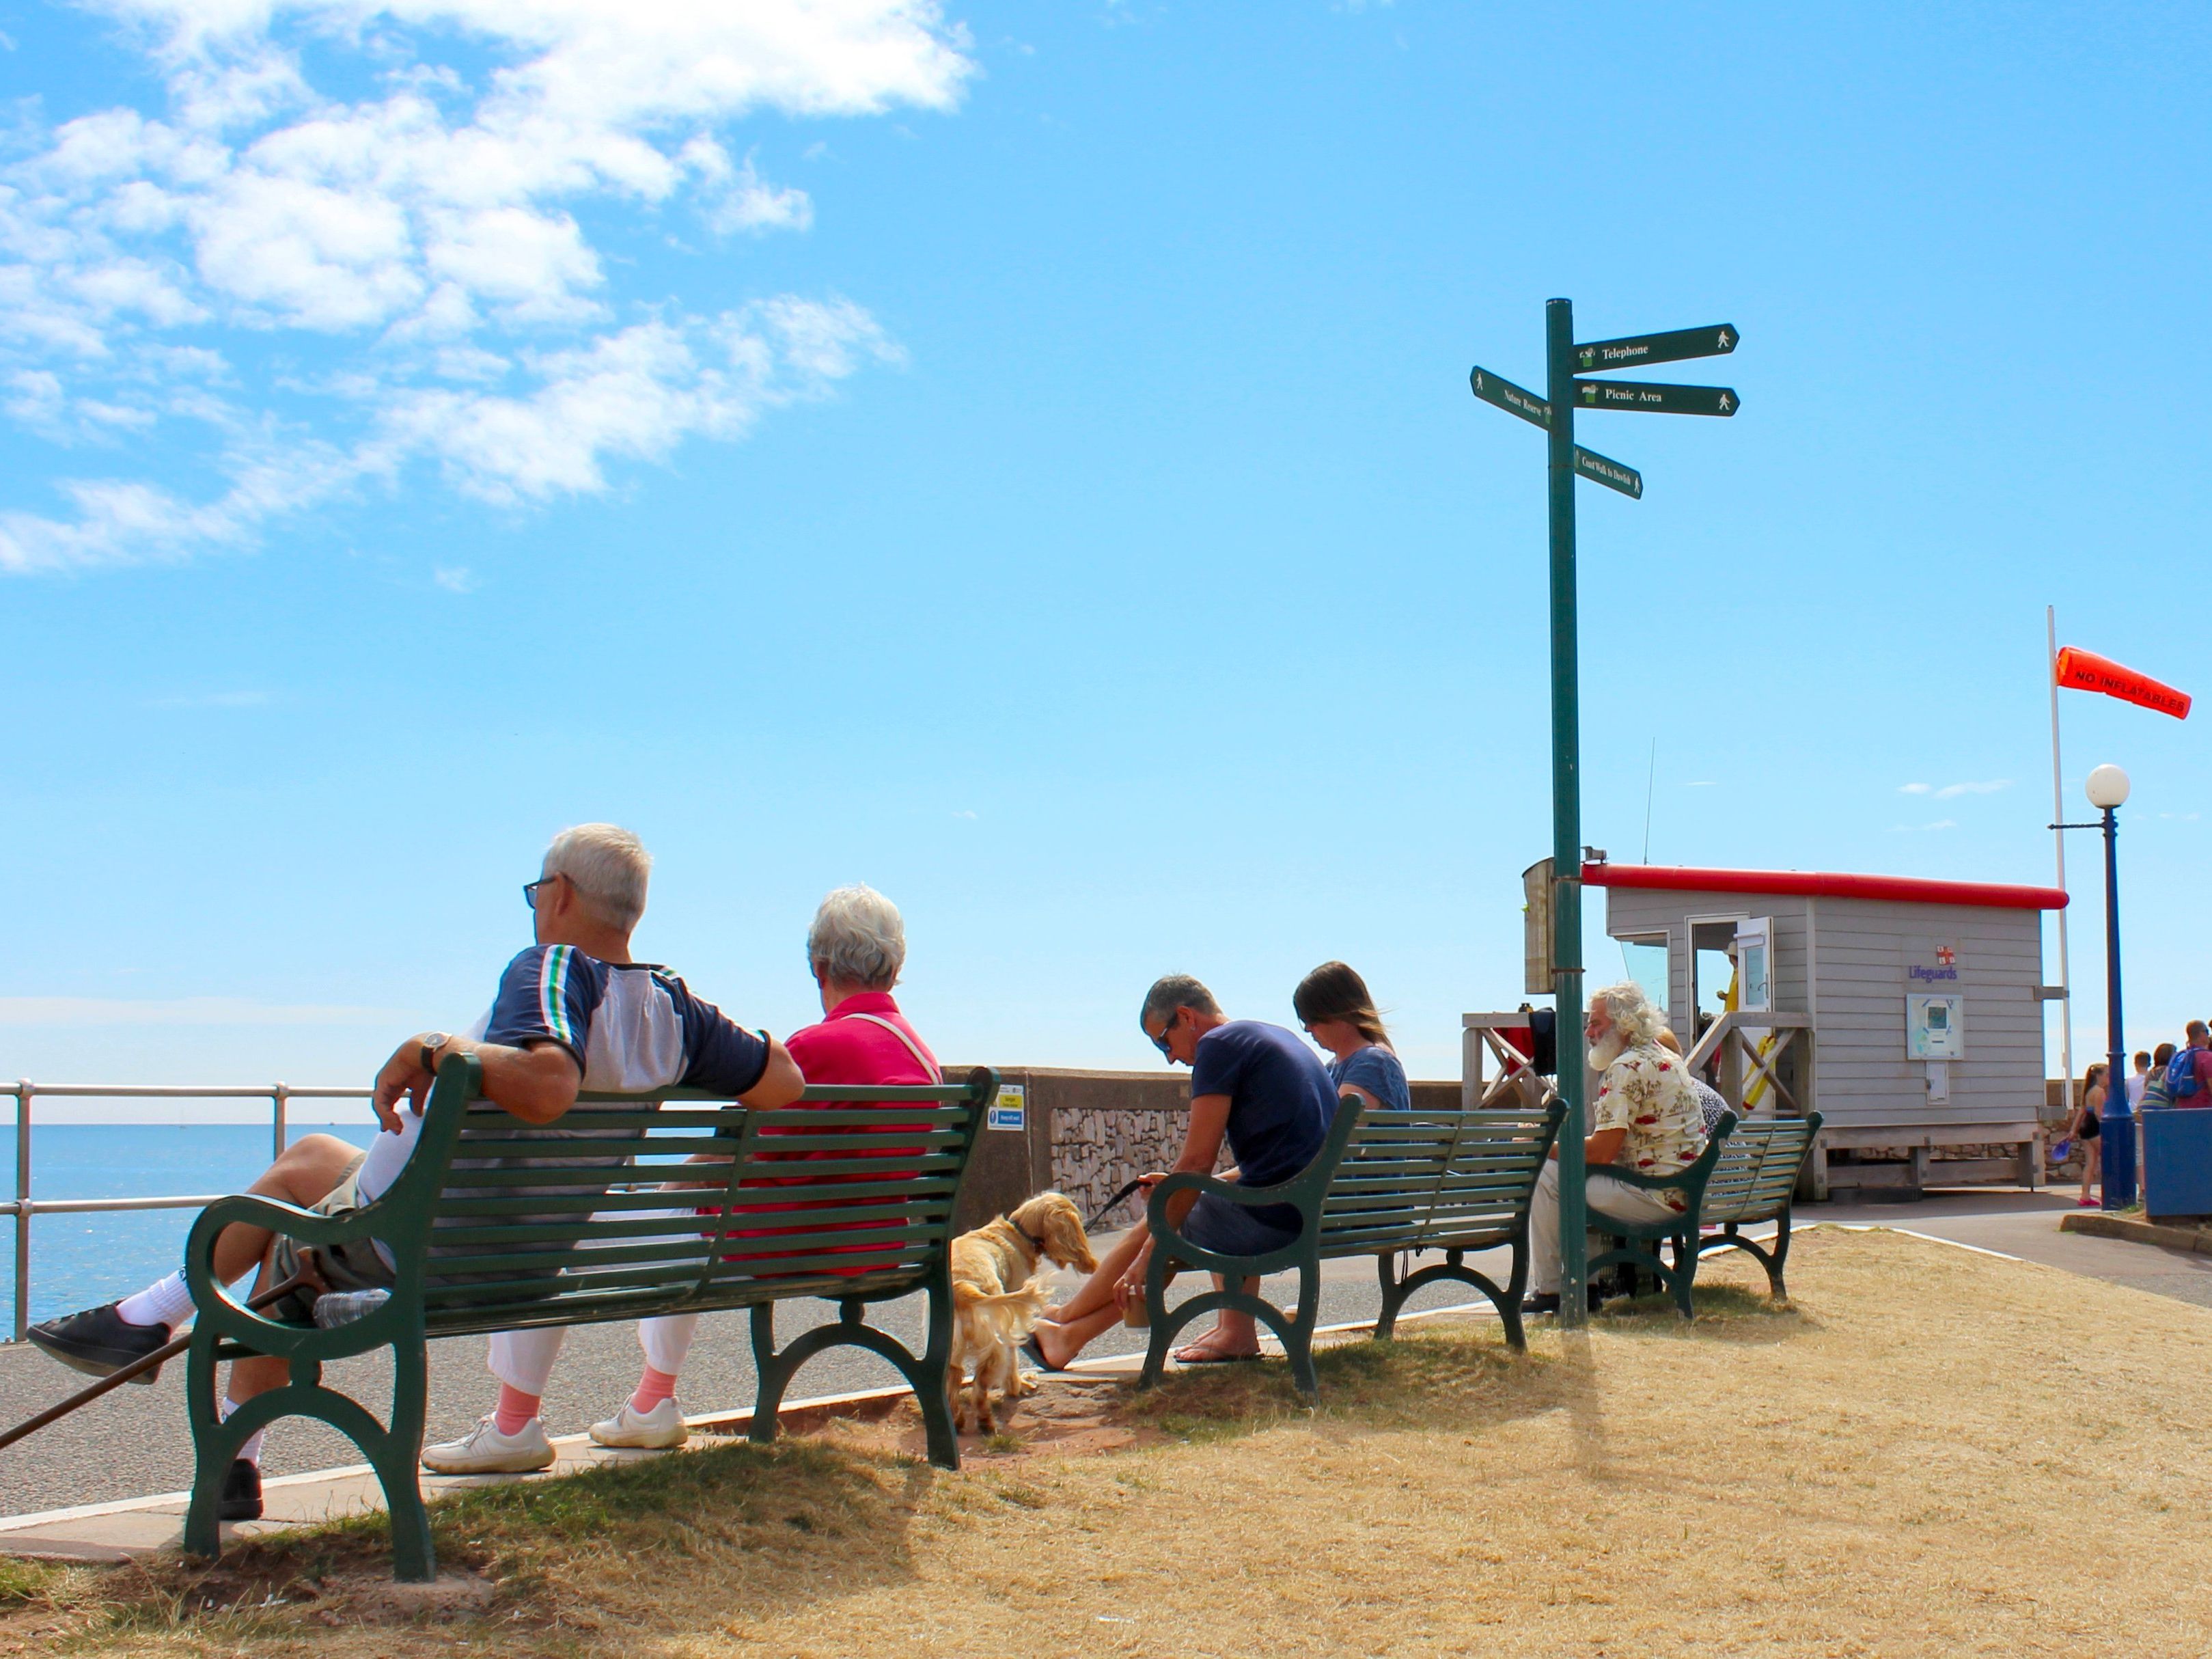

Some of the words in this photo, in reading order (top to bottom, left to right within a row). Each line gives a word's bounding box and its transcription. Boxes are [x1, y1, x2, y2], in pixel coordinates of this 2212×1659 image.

[1602, 345, 1649, 359] Telephone
[1605, 388, 1634, 400] Picnic
[1639, 391, 1662, 402] Area
[2076, 671, 2096, 683] NO
[2101, 677, 2185, 711] INFLATABLES
[1909, 965, 1957, 983] Lifeguards
